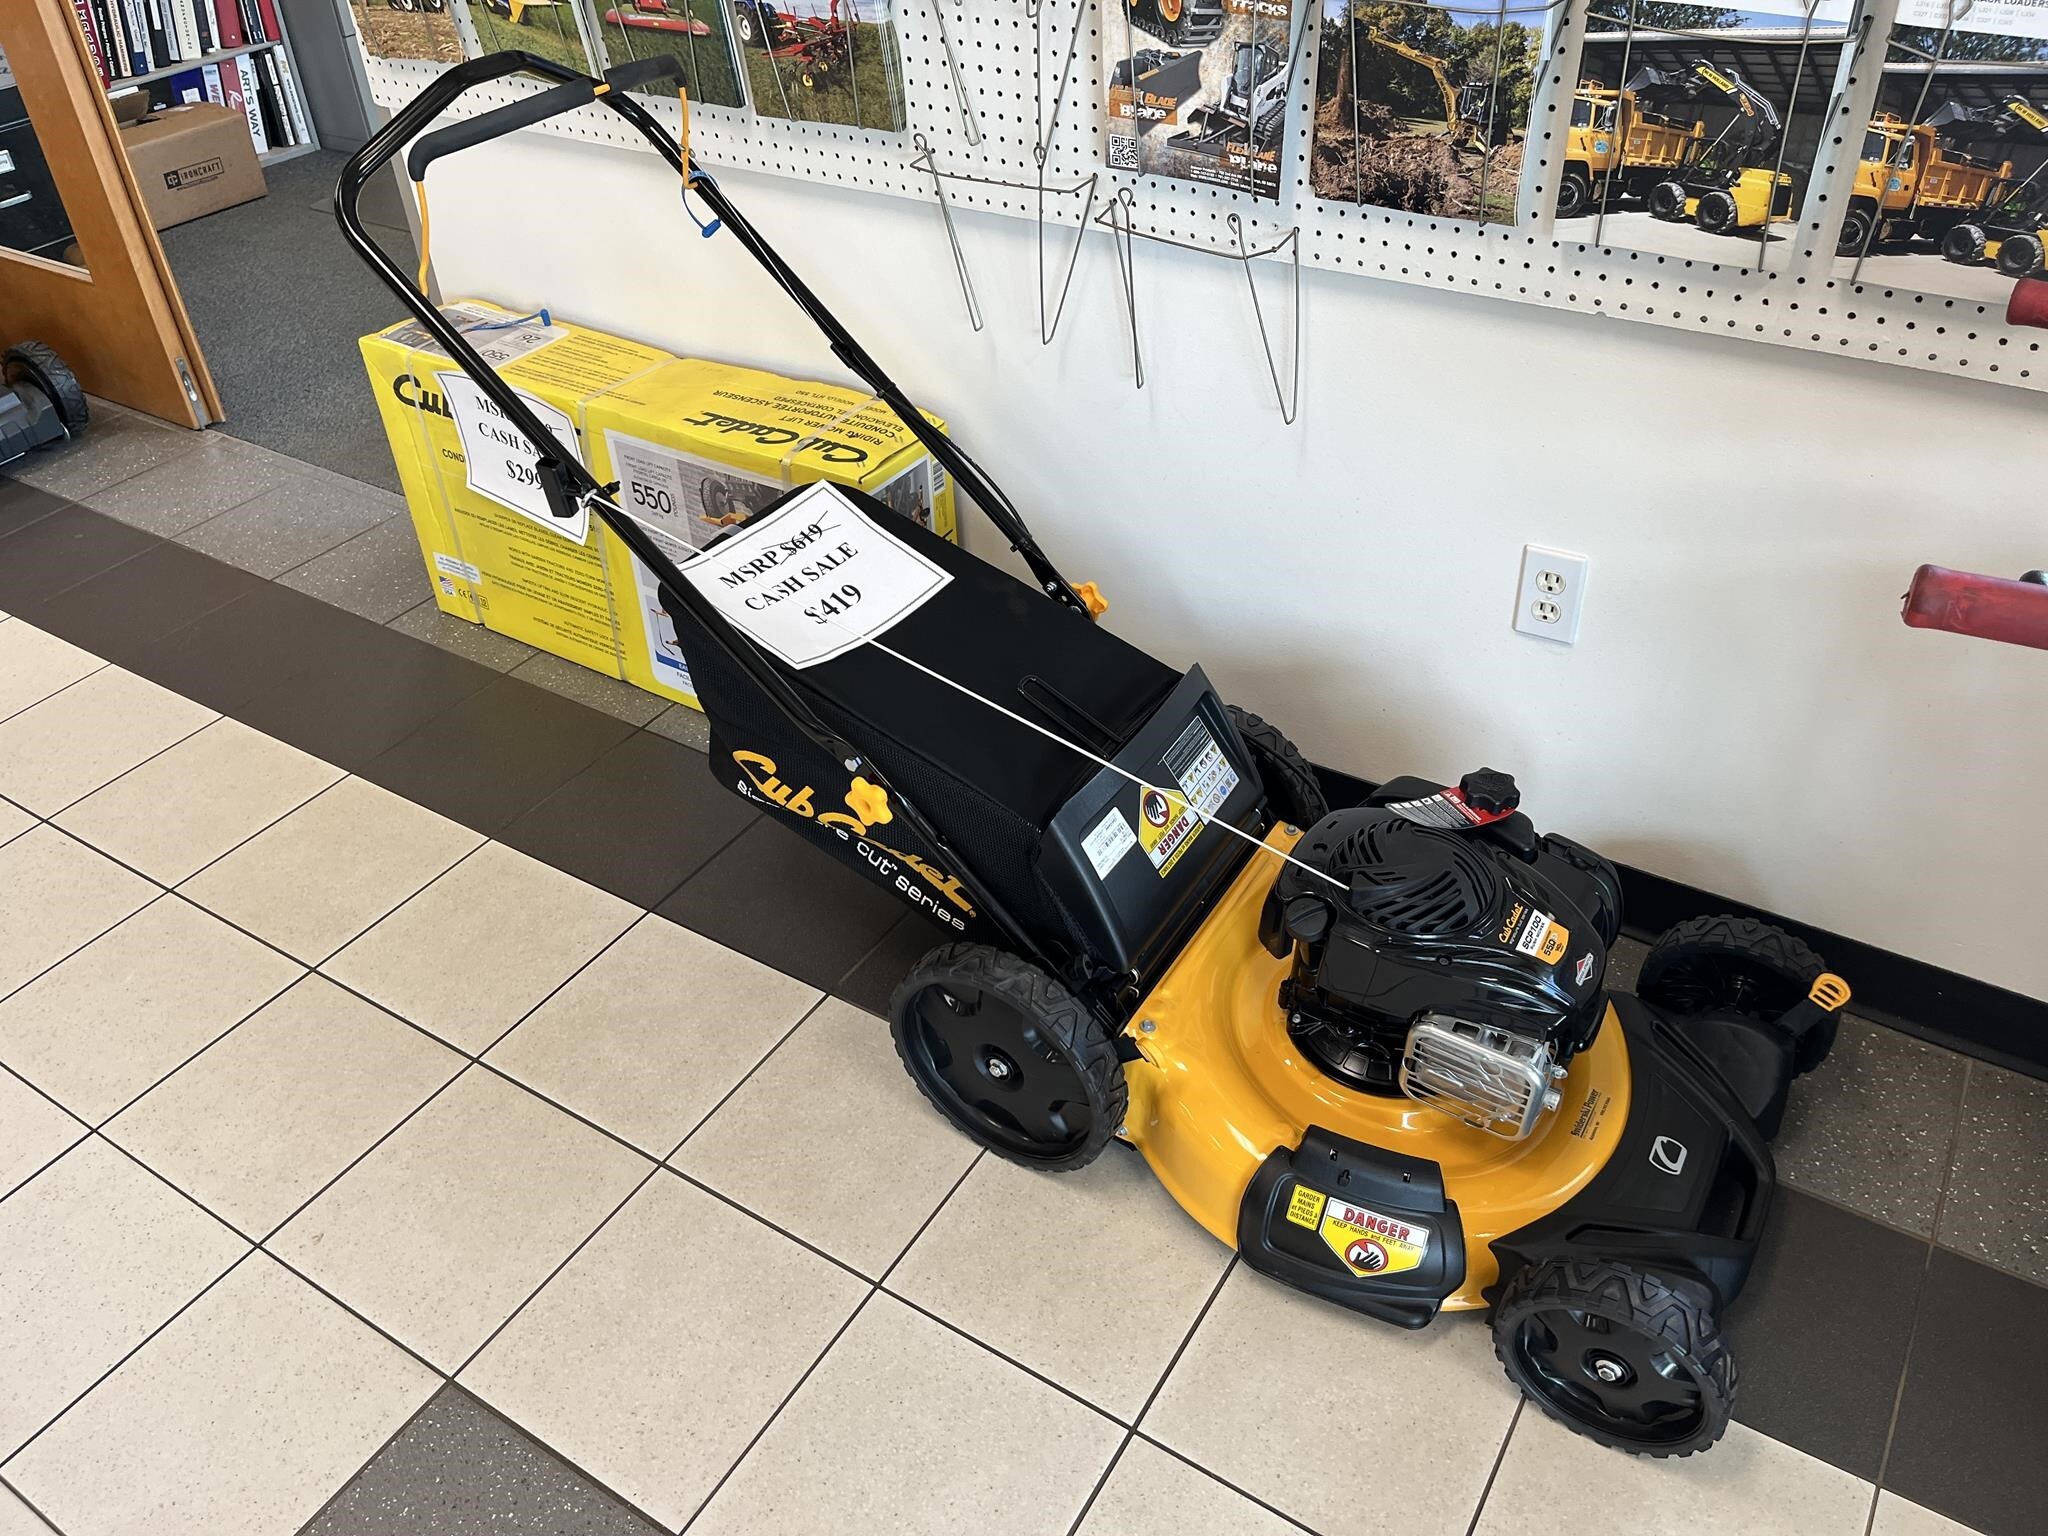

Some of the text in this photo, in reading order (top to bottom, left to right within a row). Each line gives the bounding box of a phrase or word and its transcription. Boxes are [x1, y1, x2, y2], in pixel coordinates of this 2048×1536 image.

[248, 108, 261, 137] WAY
[180, 161, 223, 181] IRONCRAFT
[481, 349, 511, 361] 550
[681, 405, 799, 451] Cadet
[779, 414, 804, 426] LIFT
[842, 418, 896, 439] CONDUITE
[478, 422, 520, 450] CASH
[846, 430, 884, 446] RIDING
[442, 448, 465, 465] COND
[632, 480, 672, 514] 550
[718, 550, 780, 590] MSRP
[744, 541, 859, 612] CASH SALE
[803, 584, 862, 625] $419
[732, 750, 815, 818] Cub
[817, 811, 973, 914] Cdet
[1156, 816, 1191, 856] DANGER
[894, 874, 966, 931] series
[1497, 901, 1524, 943] Cub Cadet
[1521, 915, 1542, 950] SCP100
[1570, 1088, 1599, 1137] Swiderski Power
[1296, 1197, 1316, 1210] MAINS
[1297, 1189, 1321, 1203] GARDER
[1289, 1211, 1316, 1227] DISTANCE
[1297, 1205, 1314, 1217] PIEDS
[1343, 1207, 1411, 1242] DANGER
[1331, 1219, 1348, 1230] KEEP
[1349, 1226, 1369, 1237] HANDS
[1382, 1237, 1397, 1248] FEET
